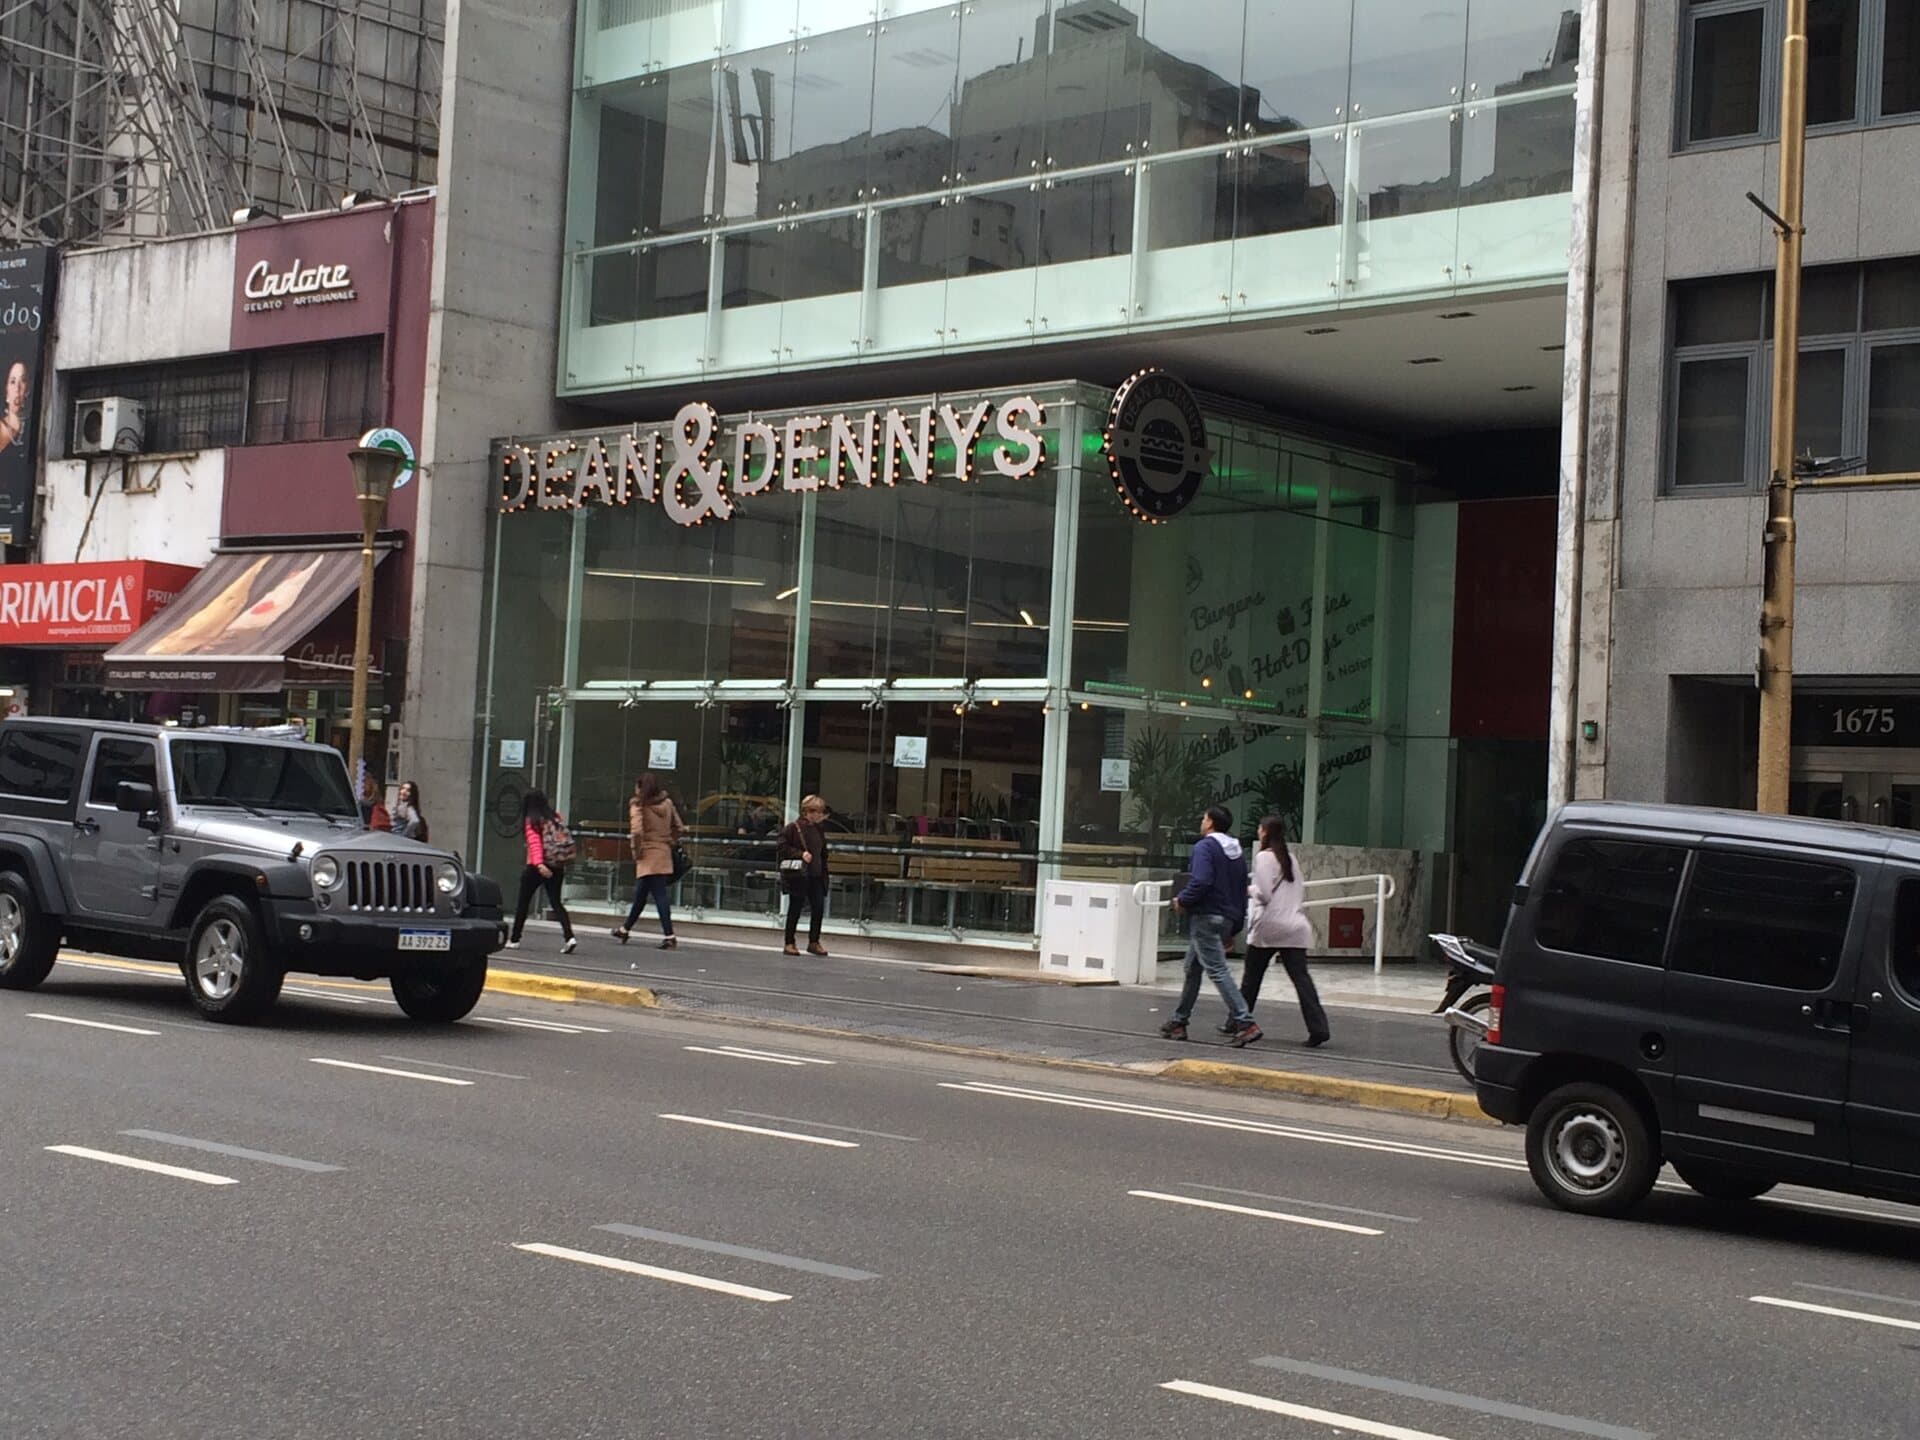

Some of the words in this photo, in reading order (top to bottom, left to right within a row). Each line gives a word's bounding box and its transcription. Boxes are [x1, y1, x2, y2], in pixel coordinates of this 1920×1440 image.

[245, 258, 350, 298] Cadore
[243, 300, 282, 312] GELATO
[293, 290, 356, 305] ARTIGIANALE
[501, 430, 662, 513] DEAN
[663, 401, 735, 527] &
[731, 396, 1049, 496] DENNYS
[0, 575, 130, 629] RIMICIA
[1188, 591, 1265, 632] Burgers
[1300, 592, 1353, 628] Fies
[299, 642, 377, 670] Cadoe
[1832, 708, 1895, 733] 1675
[401, 935, 413, 947] AA
[415, 936, 434, 948] 392
